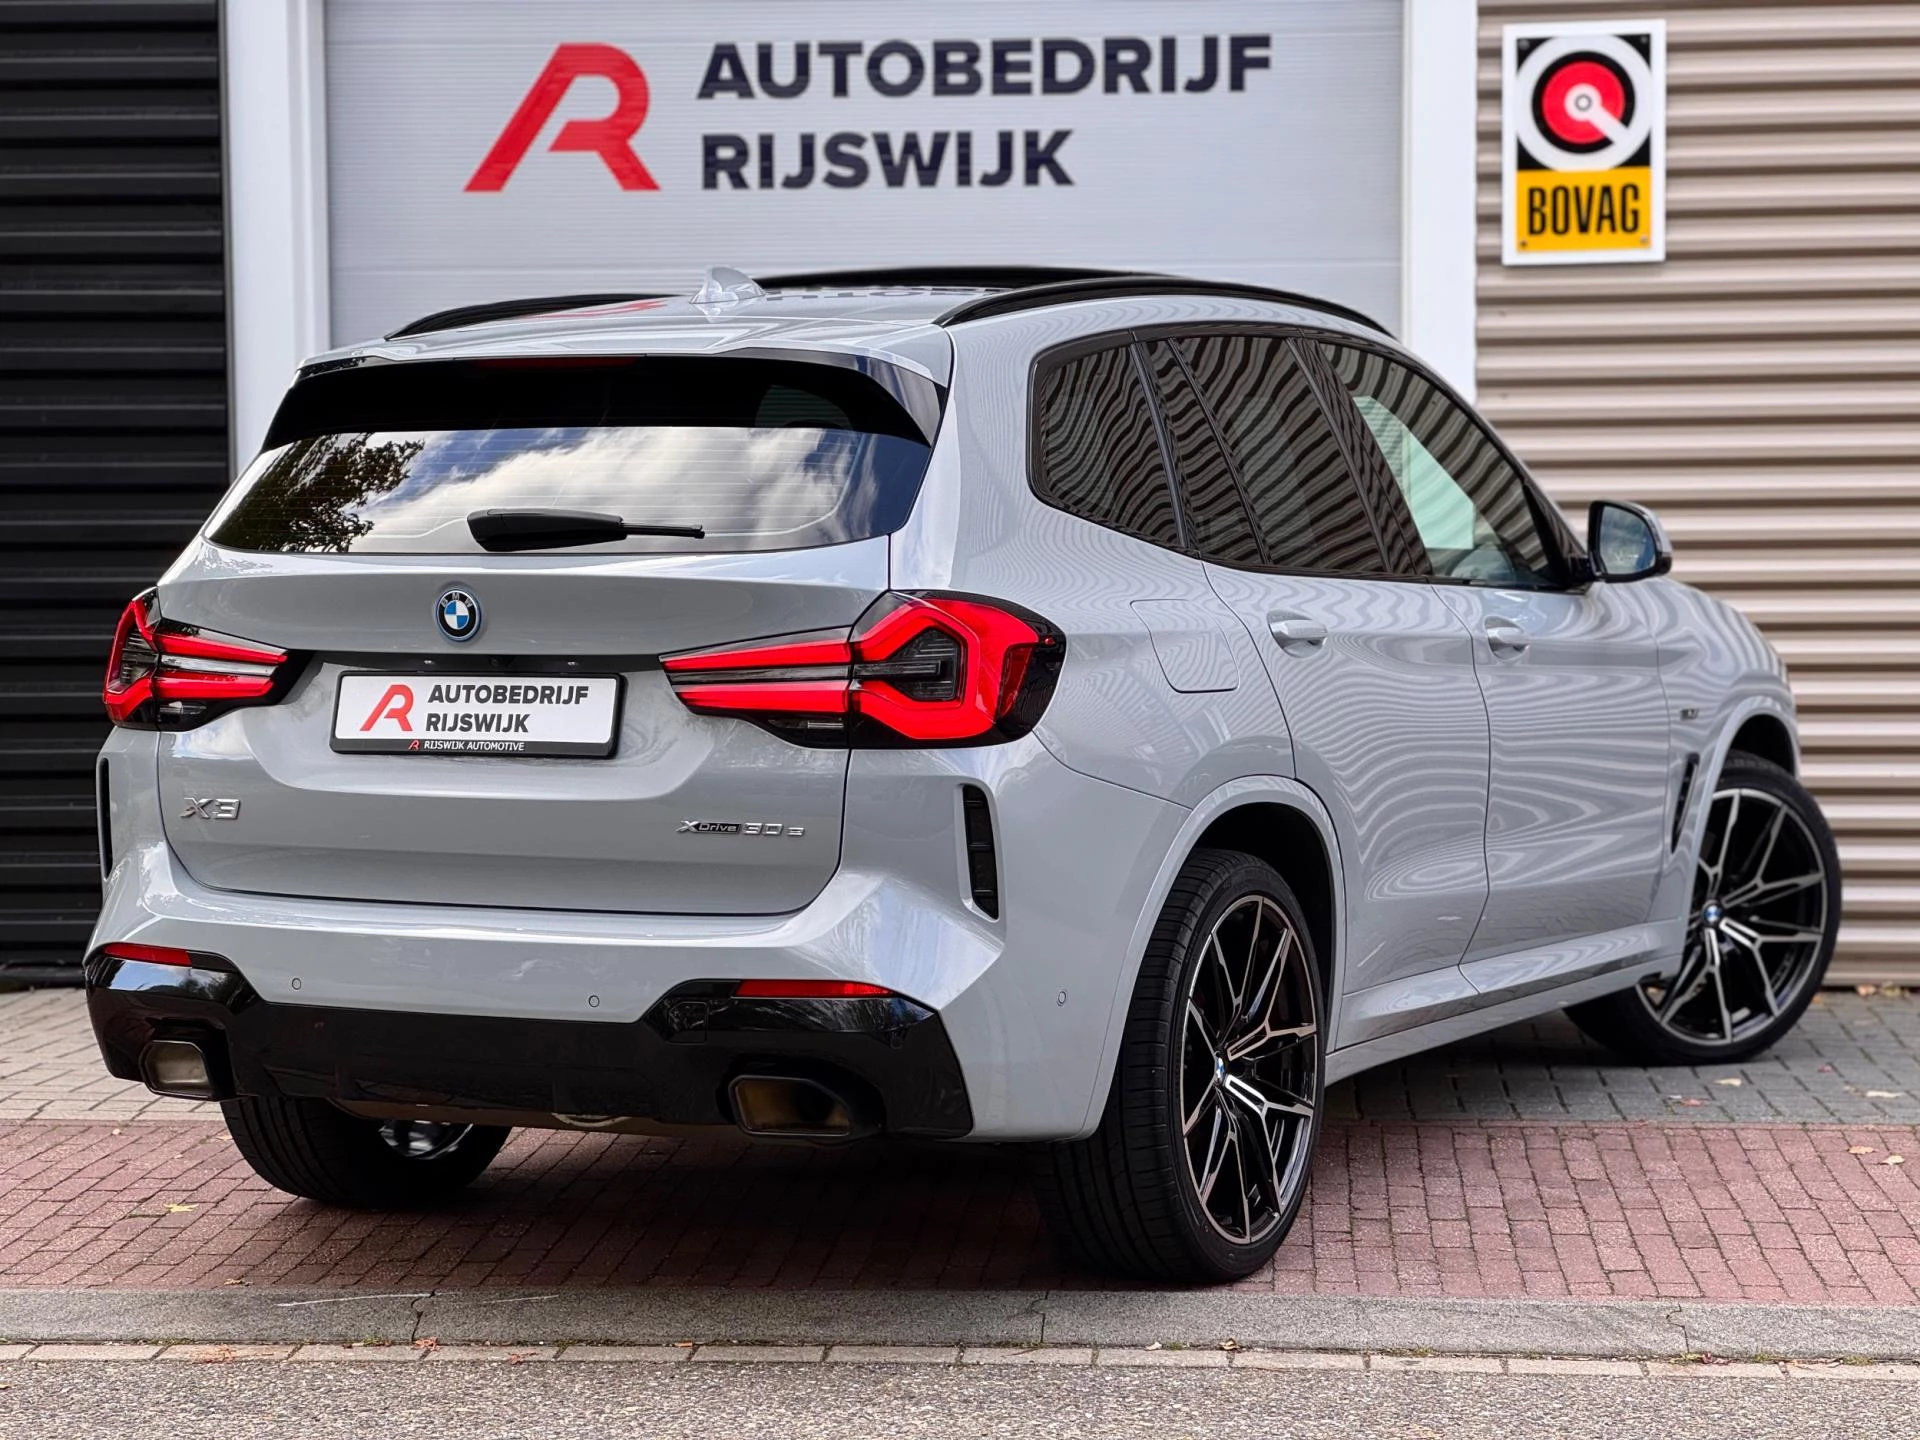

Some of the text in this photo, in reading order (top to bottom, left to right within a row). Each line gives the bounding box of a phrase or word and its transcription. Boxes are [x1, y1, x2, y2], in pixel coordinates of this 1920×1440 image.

[697, 34, 1271, 100] AUTOBEDRIJF
[702, 129, 1075, 191] RIJSWIJK
[1527, 184, 1640, 236] BOVAG
[427, 684, 589, 705] AUTOBEDRIJF
[425, 713, 530, 733] RIJSWIJK
[424, 740, 465, 750] RIJSWIJK
[466, 741, 525, 751] AUTOMOTIVE
[180, 797, 241, 819] X3
